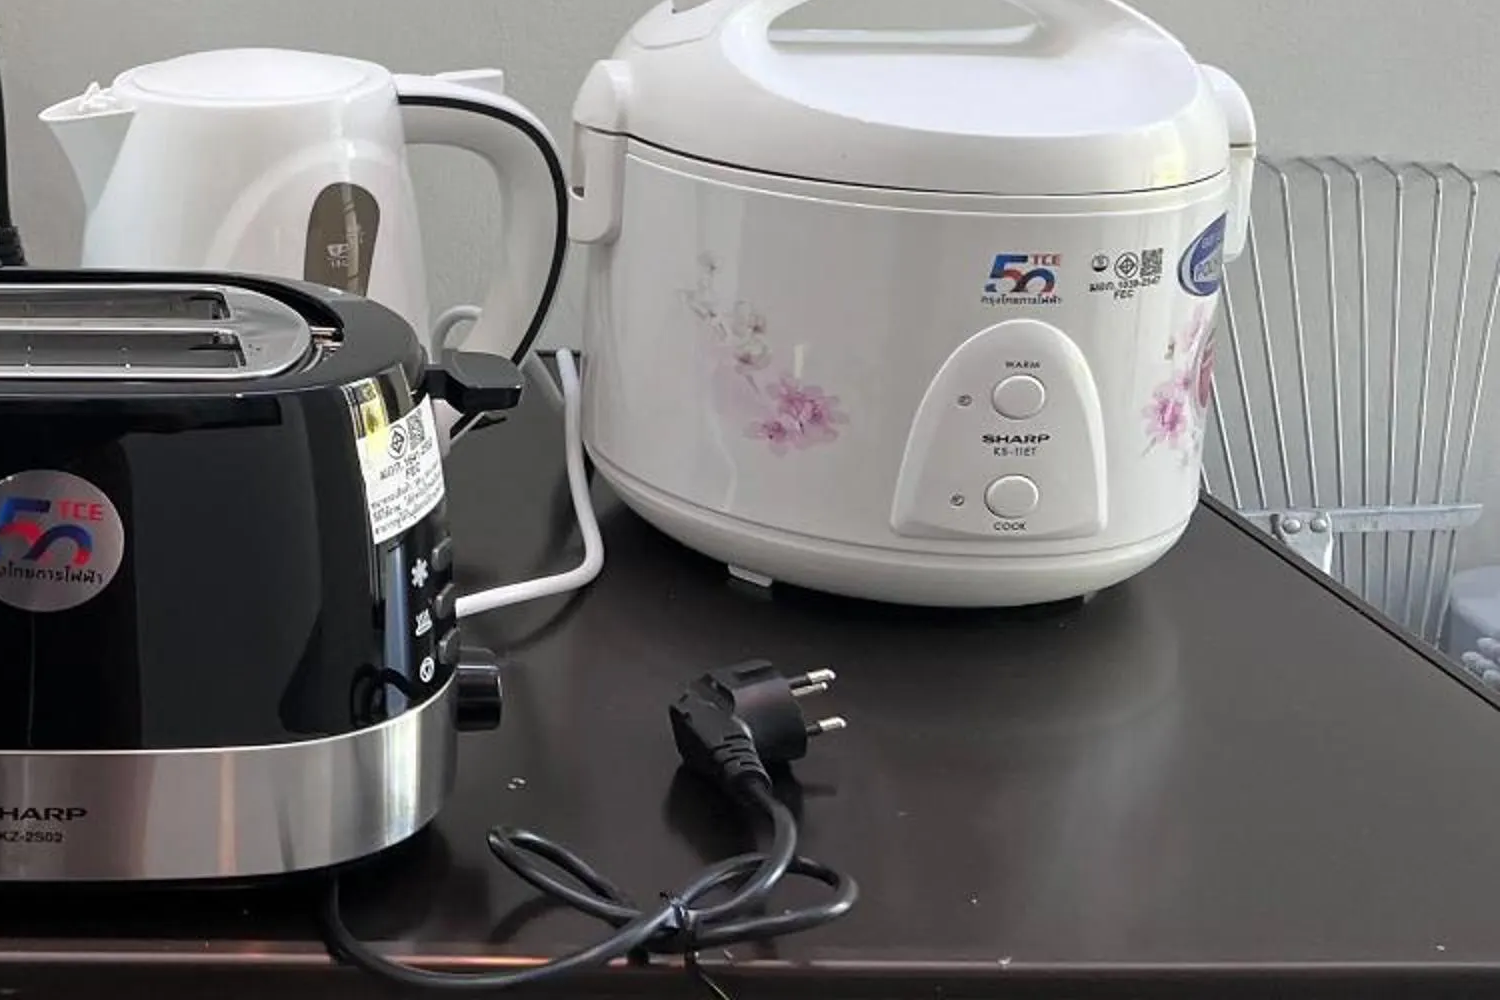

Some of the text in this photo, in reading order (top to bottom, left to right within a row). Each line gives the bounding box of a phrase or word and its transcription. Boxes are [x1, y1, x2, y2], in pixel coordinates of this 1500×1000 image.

[1030, 253, 1062, 266] TCE
[1005, 360, 1040, 368] WARM
[981, 434, 1050, 444] SHARP
[993, 447, 1036, 456] KS-11ET
[56, 500, 103, 521] TCE
[993, 521, 1027, 531] COOK
